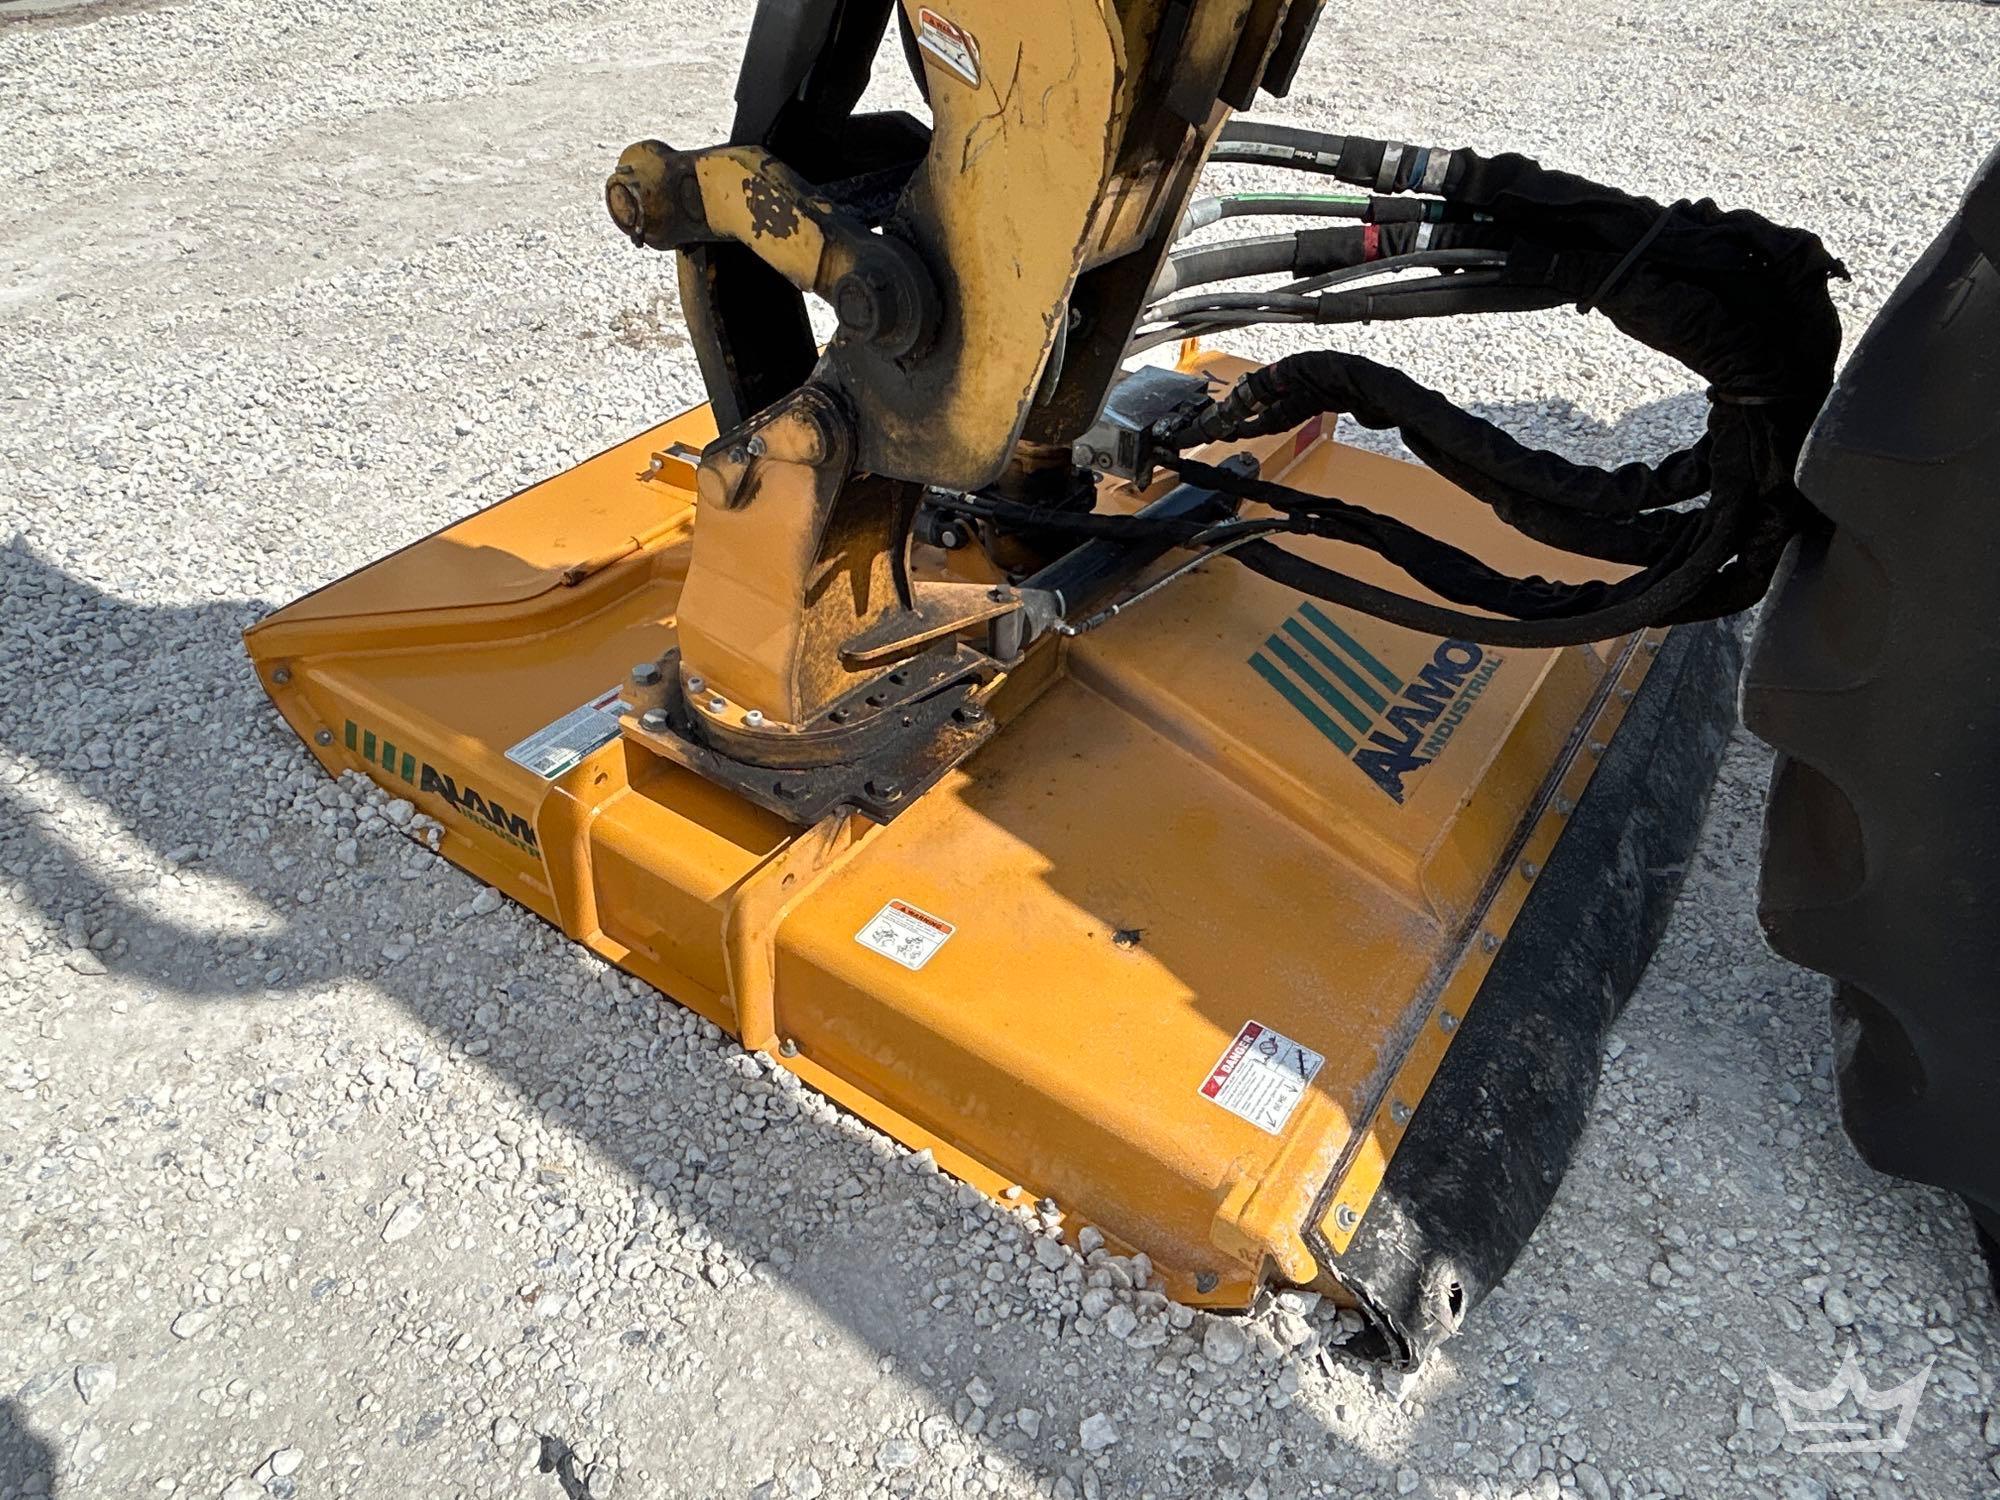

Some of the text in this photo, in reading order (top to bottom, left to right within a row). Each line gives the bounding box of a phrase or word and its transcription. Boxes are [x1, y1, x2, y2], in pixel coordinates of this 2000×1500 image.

[1352, 639, 1483, 805] ALAMO
[1420, 656, 1504, 759] INDUSTRIAL
[420, 763, 538, 847] ALAM
[907, 909, 943, 930] WARNING
[1221, 1035, 1255, 1075] DANGER
